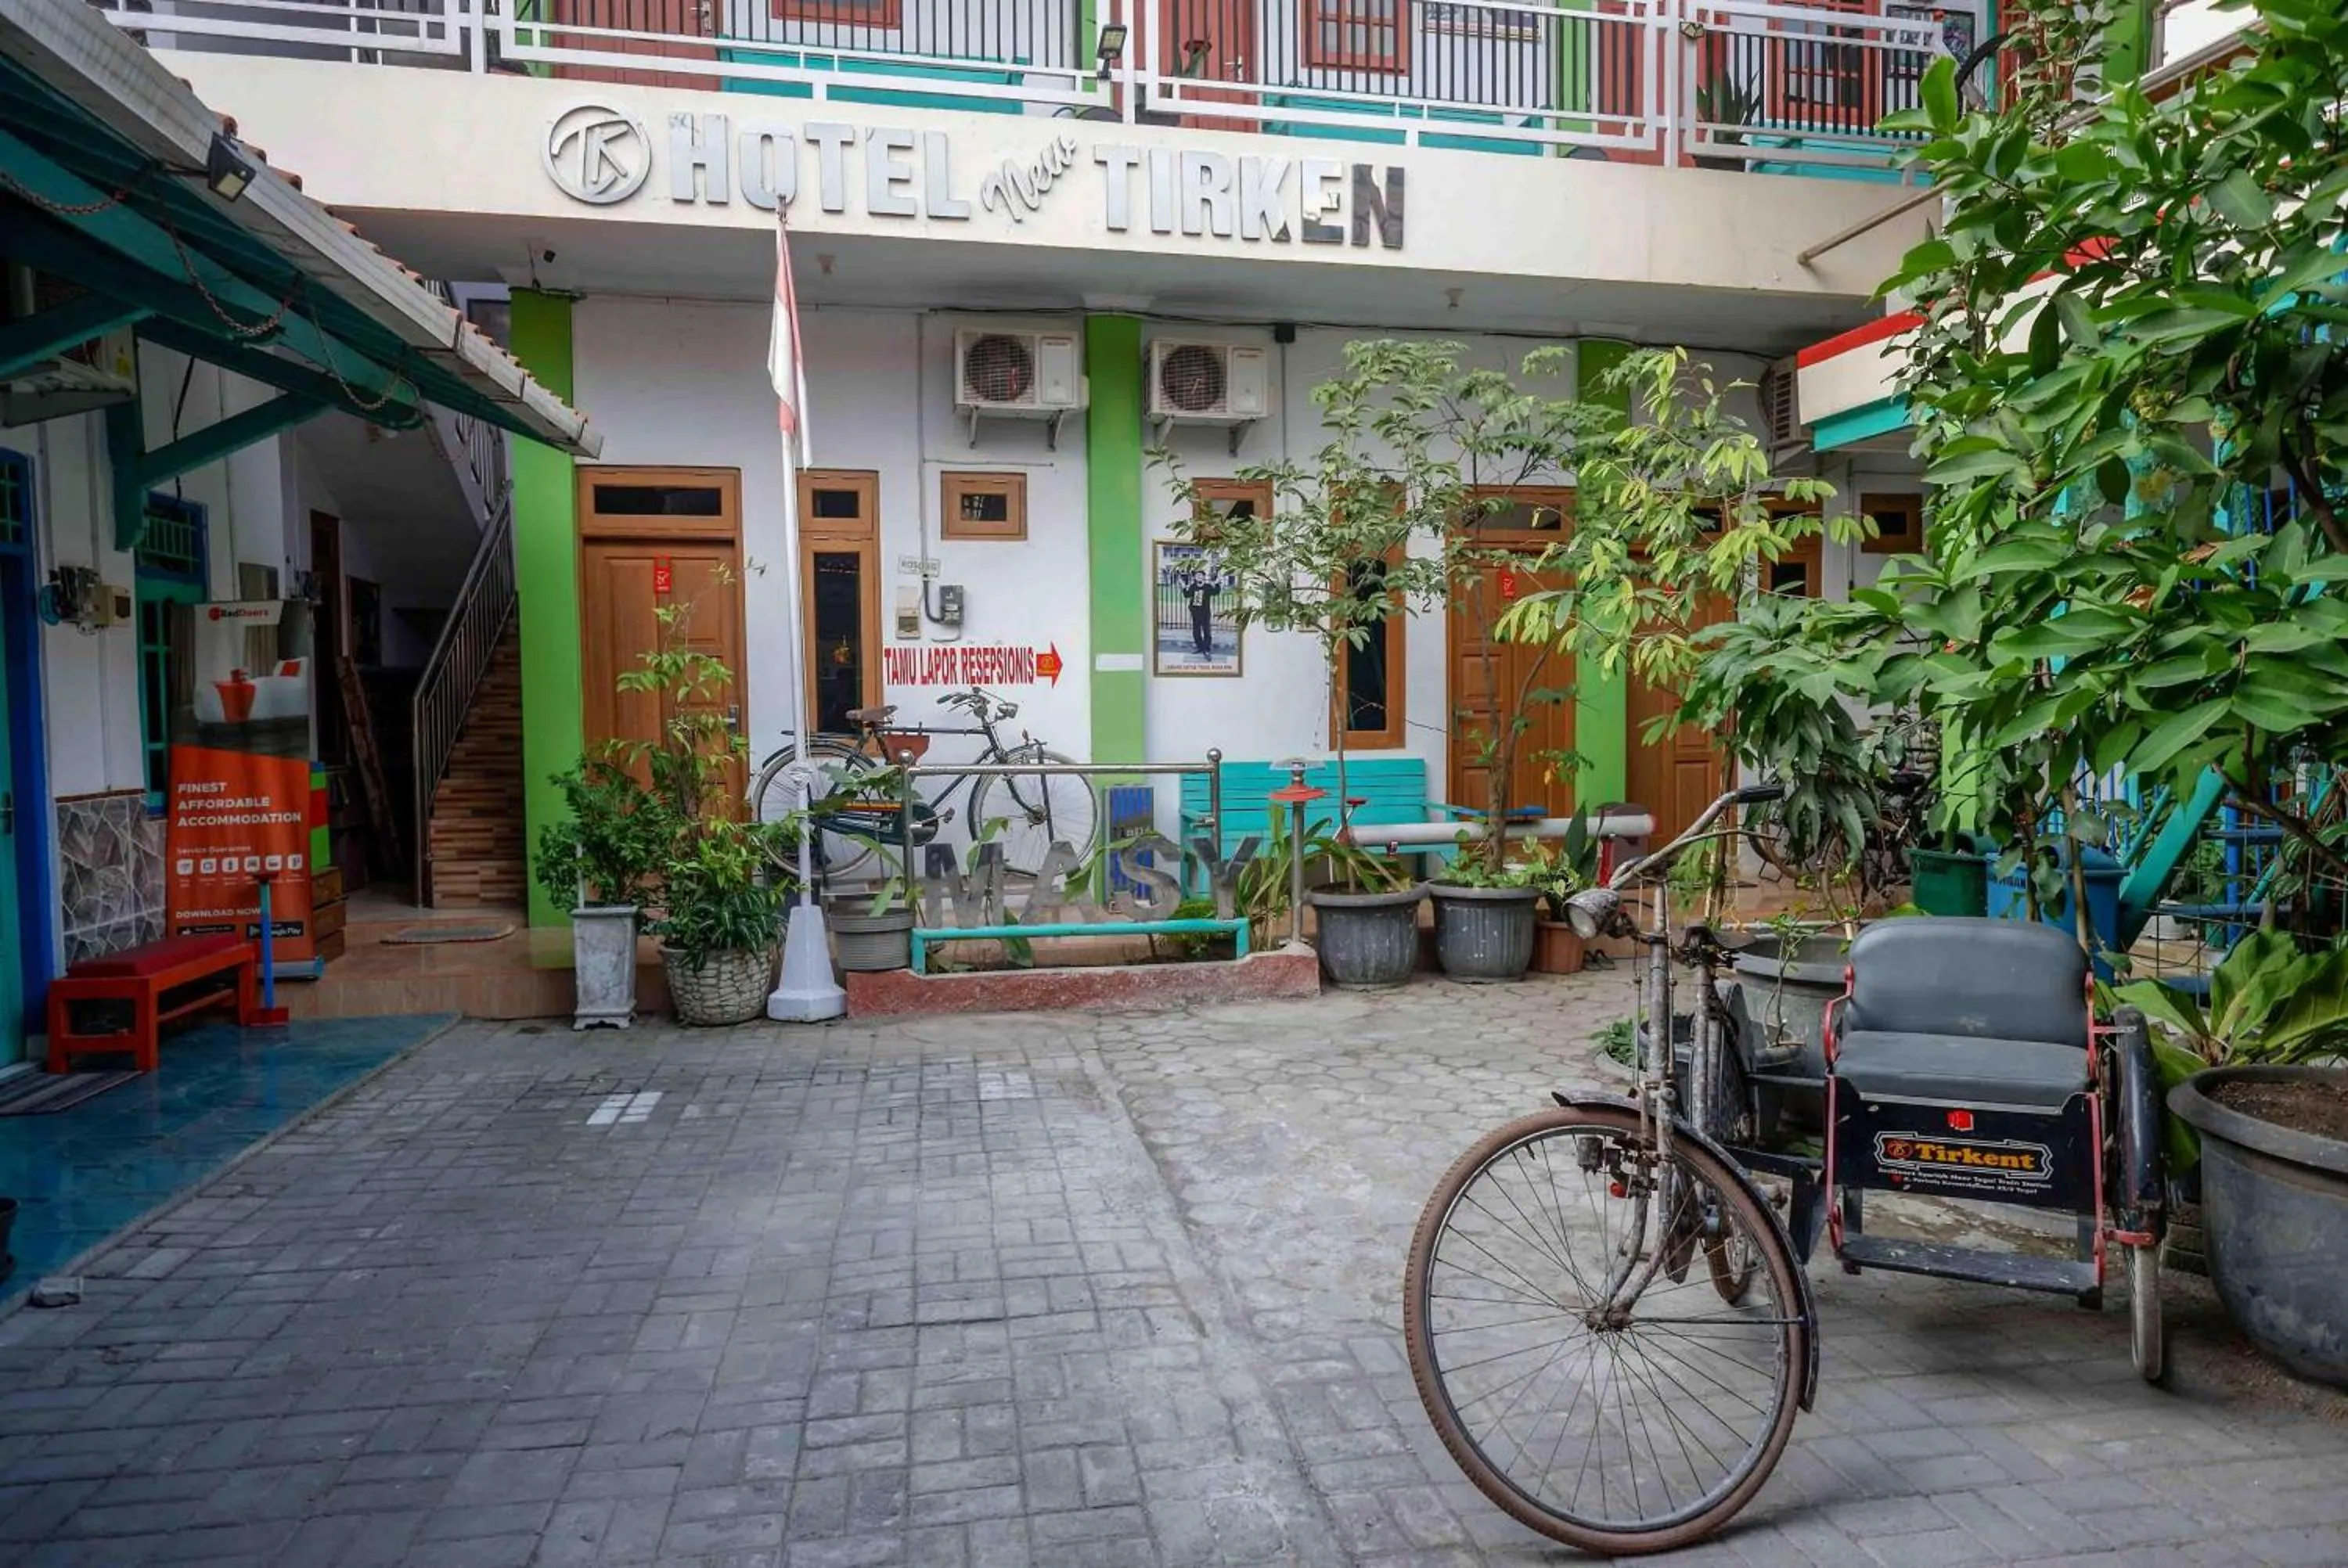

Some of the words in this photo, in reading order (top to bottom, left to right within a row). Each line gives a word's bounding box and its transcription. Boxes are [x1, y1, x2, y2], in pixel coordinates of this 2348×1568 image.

[668, 111, 971, 220] HOTEL
[980, 135, 1079, 223] New
[1094, 143, 1406, 250] TIRKEN
[1421, 595, 1431, 613] 2
[884, 647, 917, 685] TAMU
[920, 647, 957, 685] LAPOR
[962, 646, 1035, 685] RESEPSIONIS
[177, 782, 228, 793] FINEST
[177, 796, 271, 811] AFFORDABLE
[177, 811, 302, 827] ACCOMMODATION
[175, 909, 235, 919] DOWNLOAD
[236, 908, 261, 916] NOW
[1915, 1142, 2036, 1169] Tirkent
